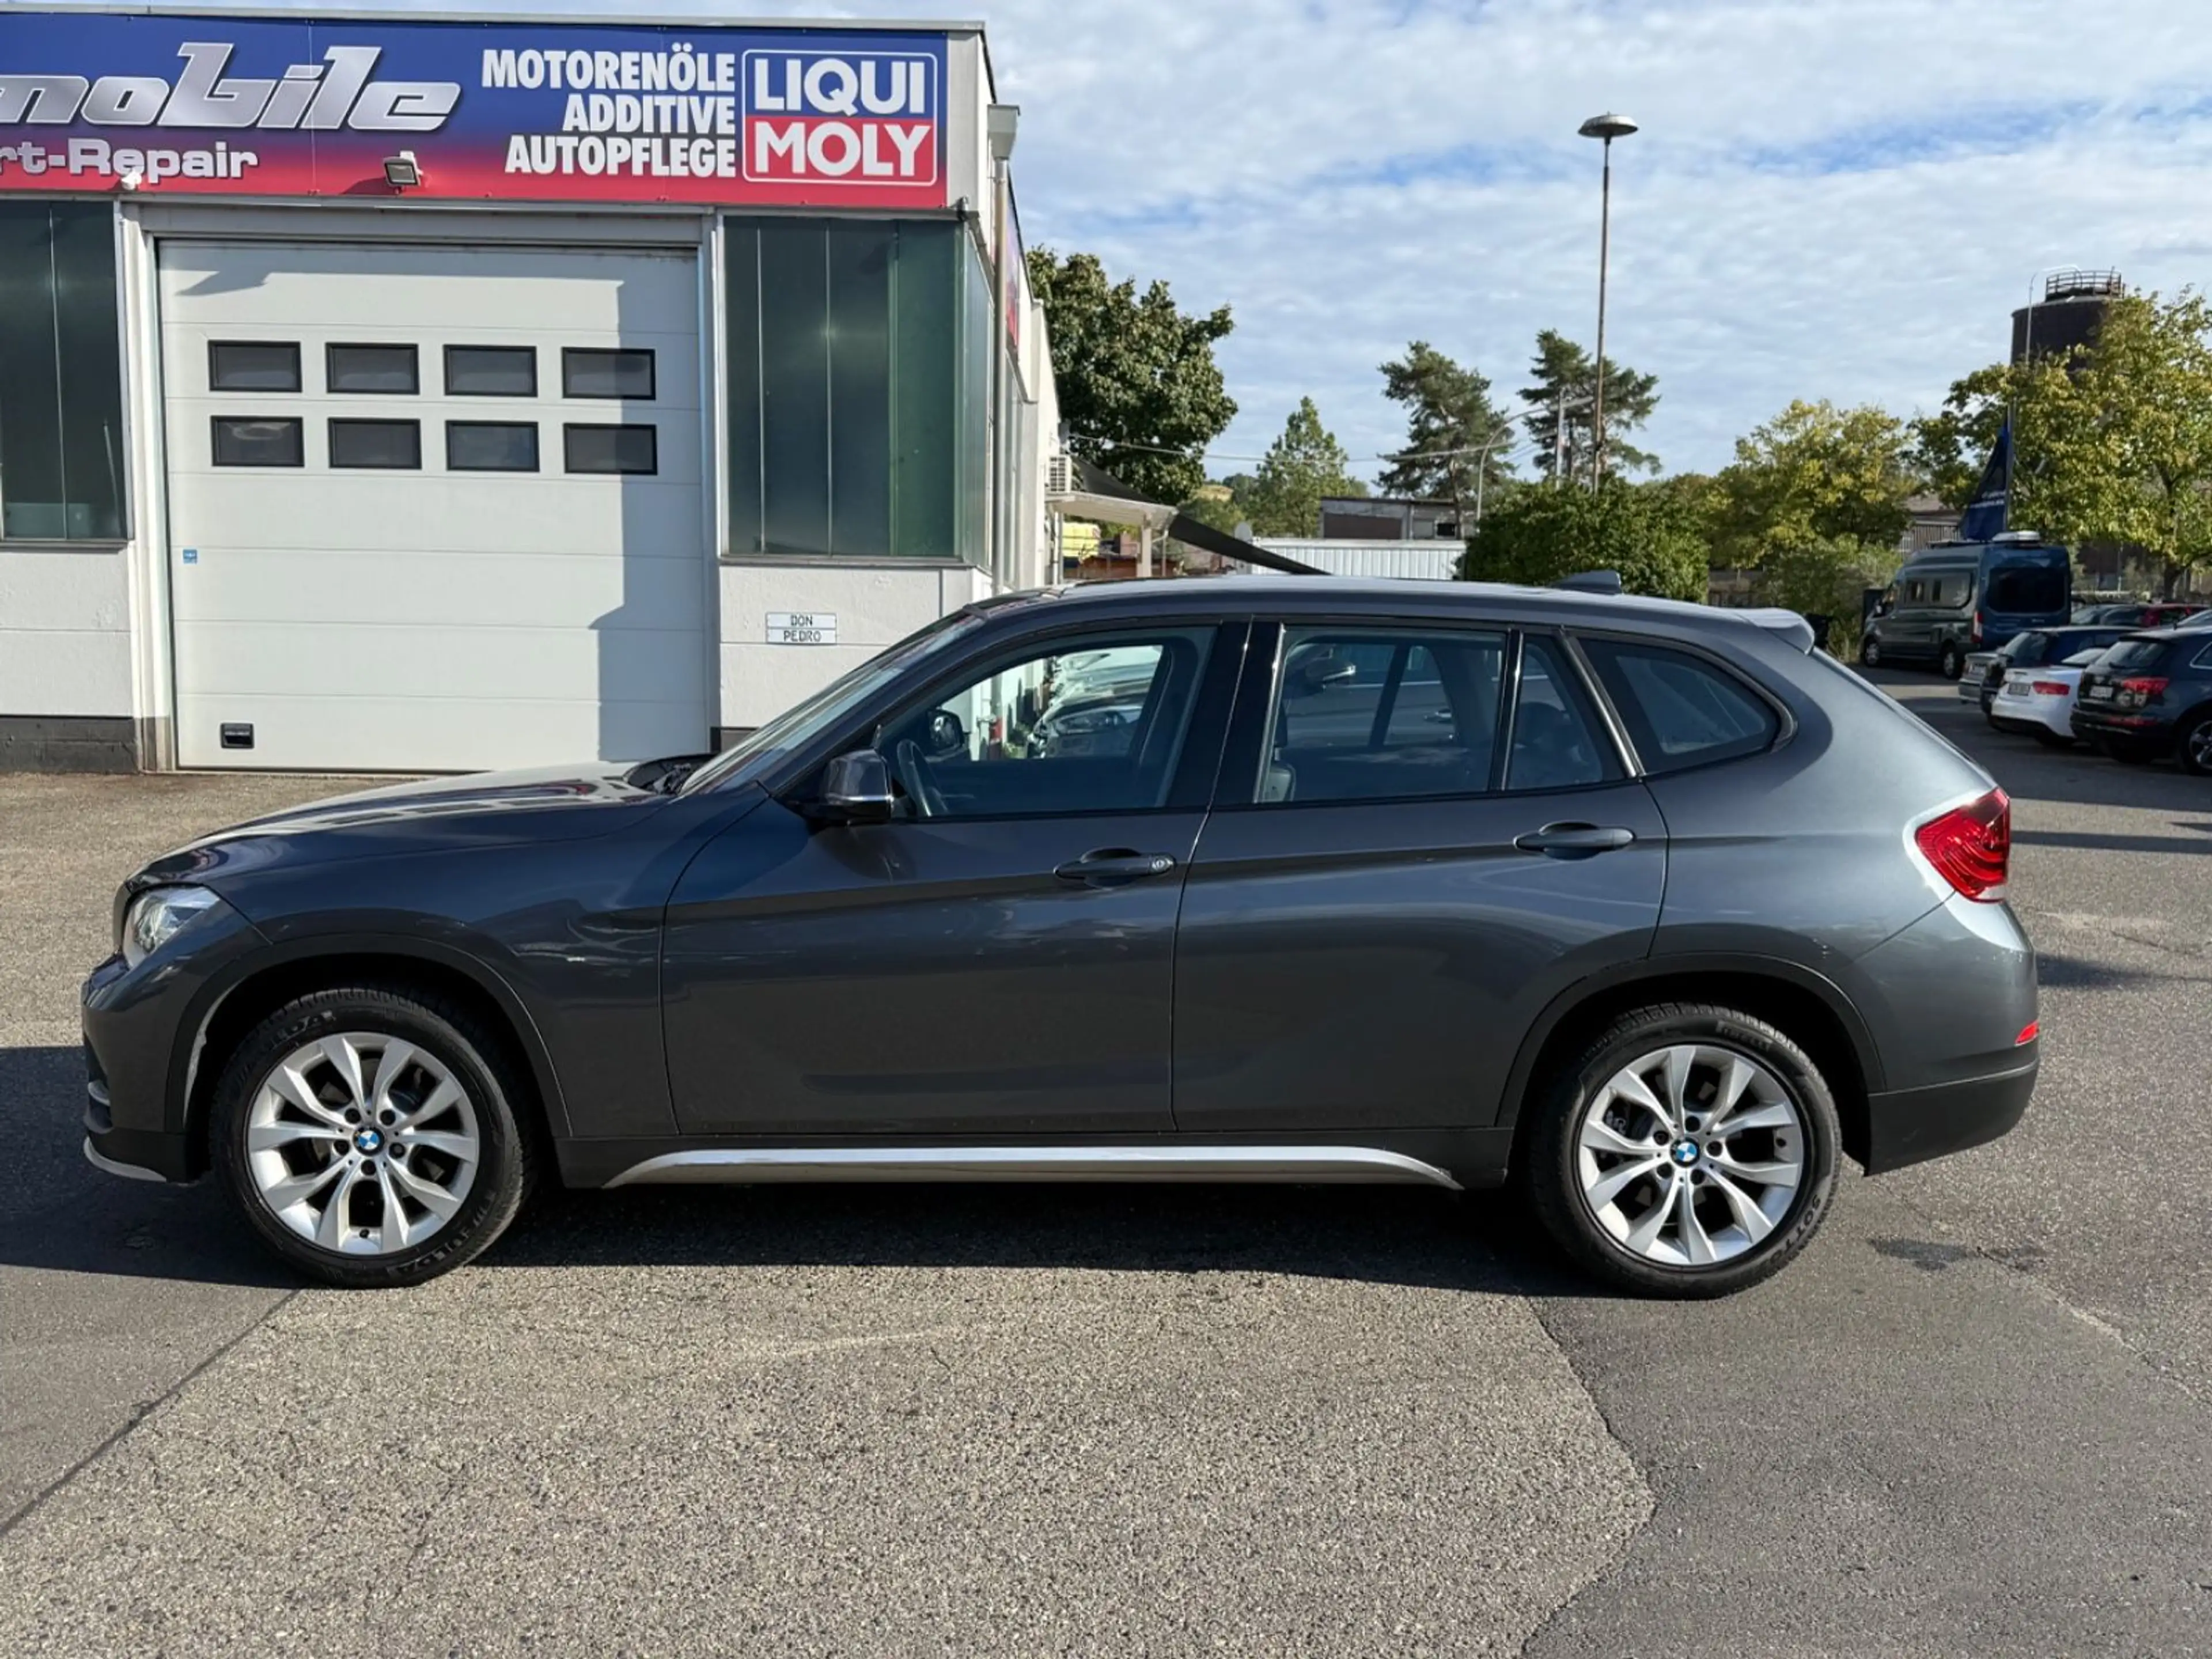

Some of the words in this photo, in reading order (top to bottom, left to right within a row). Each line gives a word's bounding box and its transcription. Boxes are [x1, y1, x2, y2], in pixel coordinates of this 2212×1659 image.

[482, 43, 736, 92] MOTORENÖLE
[755, 58, 925, 116] LIQUI
[562, 94, 736, 135] ADDITIVE
[505, 135, 736, 177] AUTOPFLEGE
[755, 121, 930, 176] MOLY
[783, 630, 821, 642] PEDRO
[790, 615, 813, 626] DON
